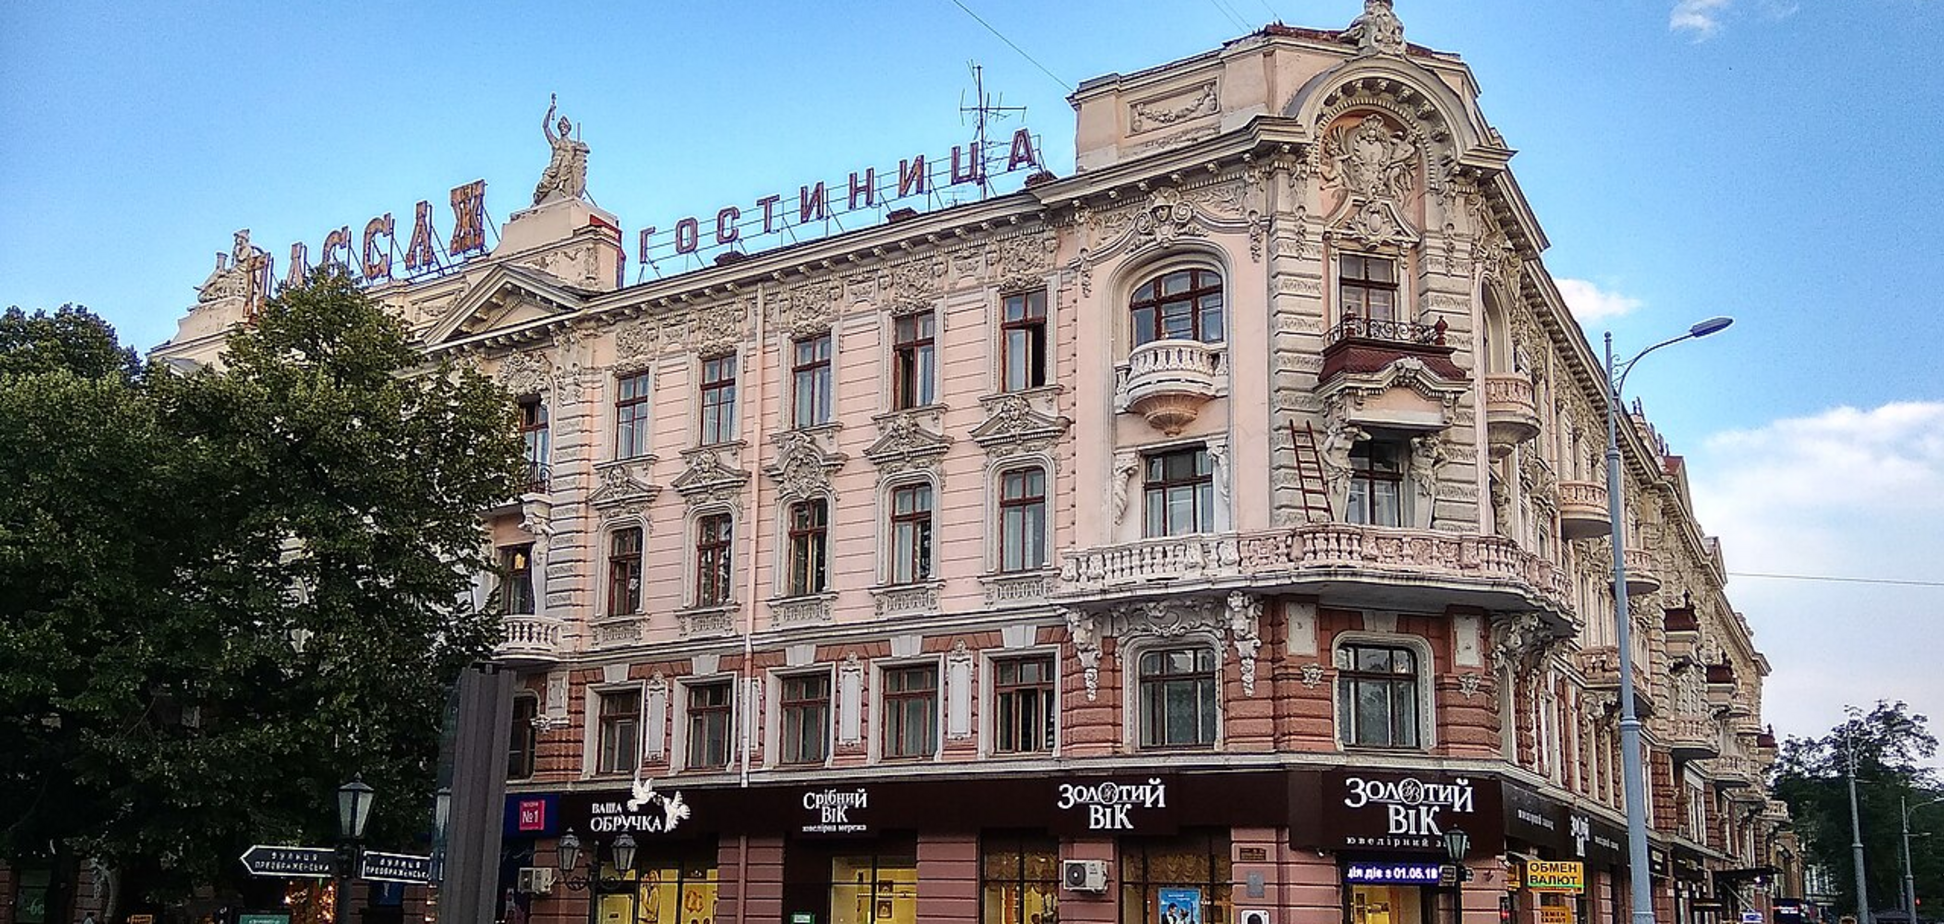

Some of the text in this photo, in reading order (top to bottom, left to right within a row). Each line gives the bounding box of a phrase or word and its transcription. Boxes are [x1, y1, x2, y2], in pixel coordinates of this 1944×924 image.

[639, 128, 1037, 264] ГОСТИНИЦА
[592, 802, 622, 814] ВАША
[590, 815, 662, 833] ОБРУЧКА
[1530, 862, 1577, 873] ОБМЕН
[1530, 874, 1578, 885] ВАЛЮТ
